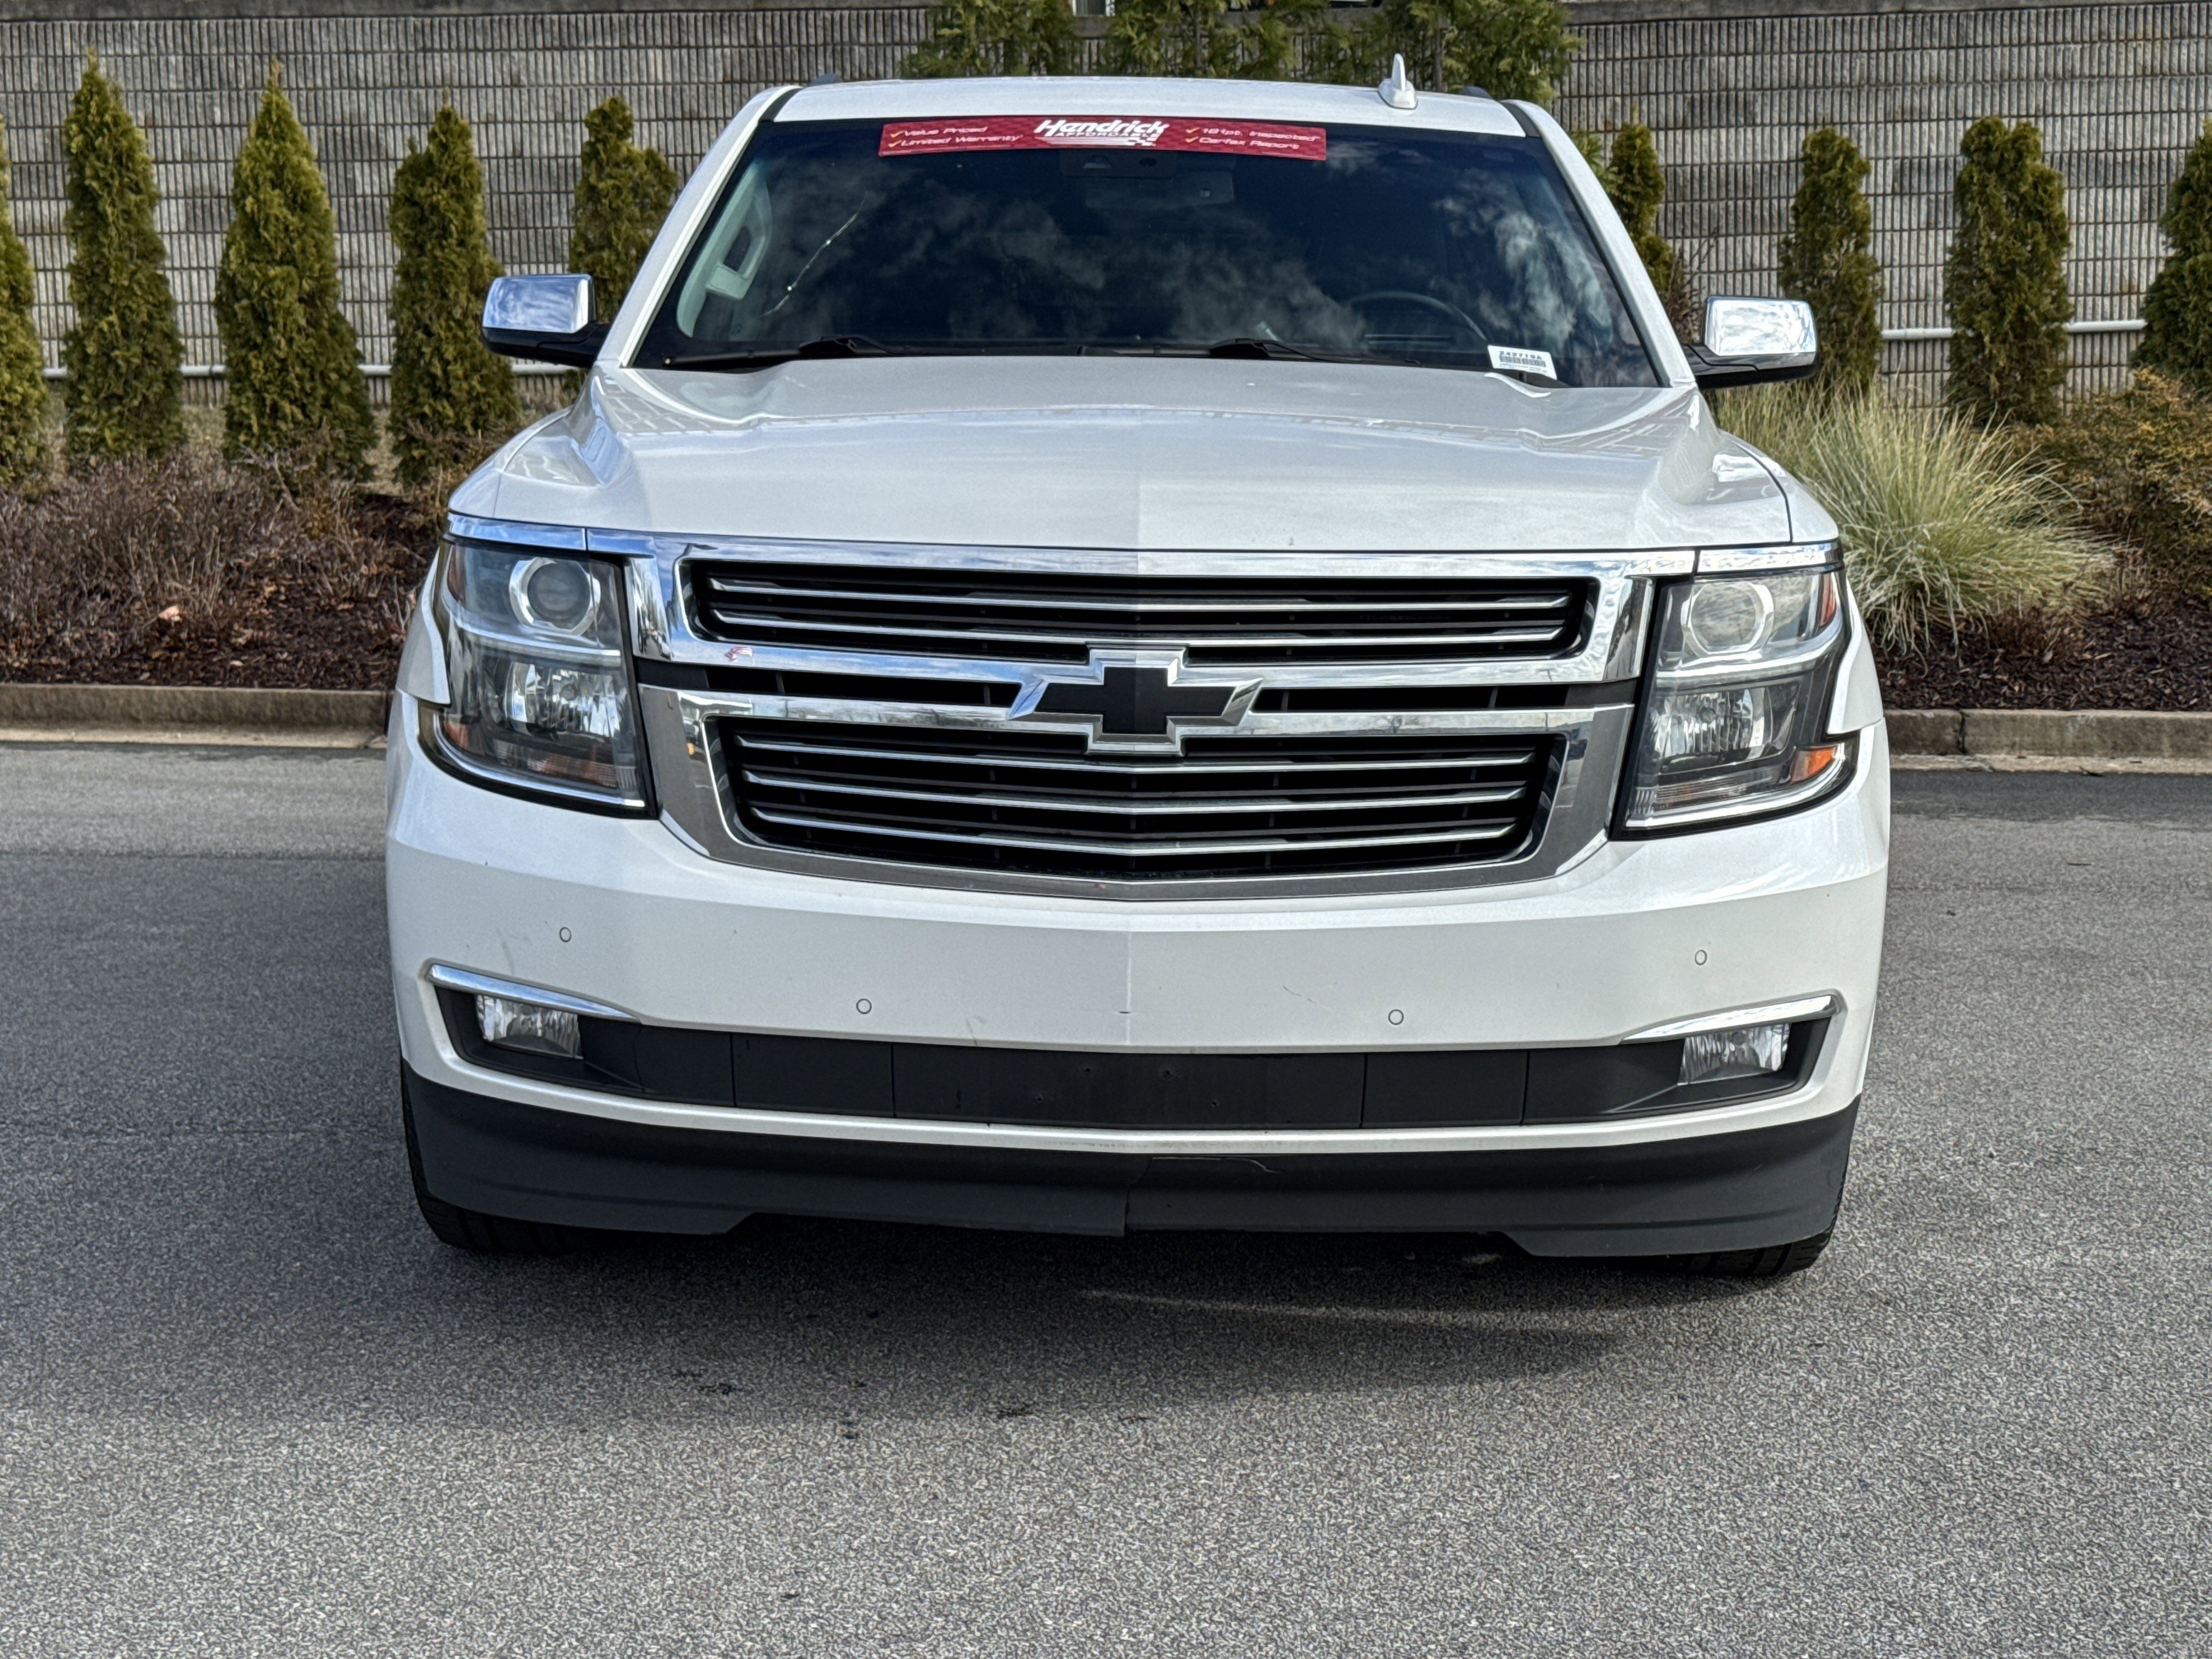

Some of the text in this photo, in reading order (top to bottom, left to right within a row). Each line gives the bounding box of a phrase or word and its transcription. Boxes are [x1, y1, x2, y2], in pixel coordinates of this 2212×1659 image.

[1034, 119, 1170, 137] Hendrick
[901, 137, 952, 146] Limited
[1199, 137, 1300, 150] Carfax Report
